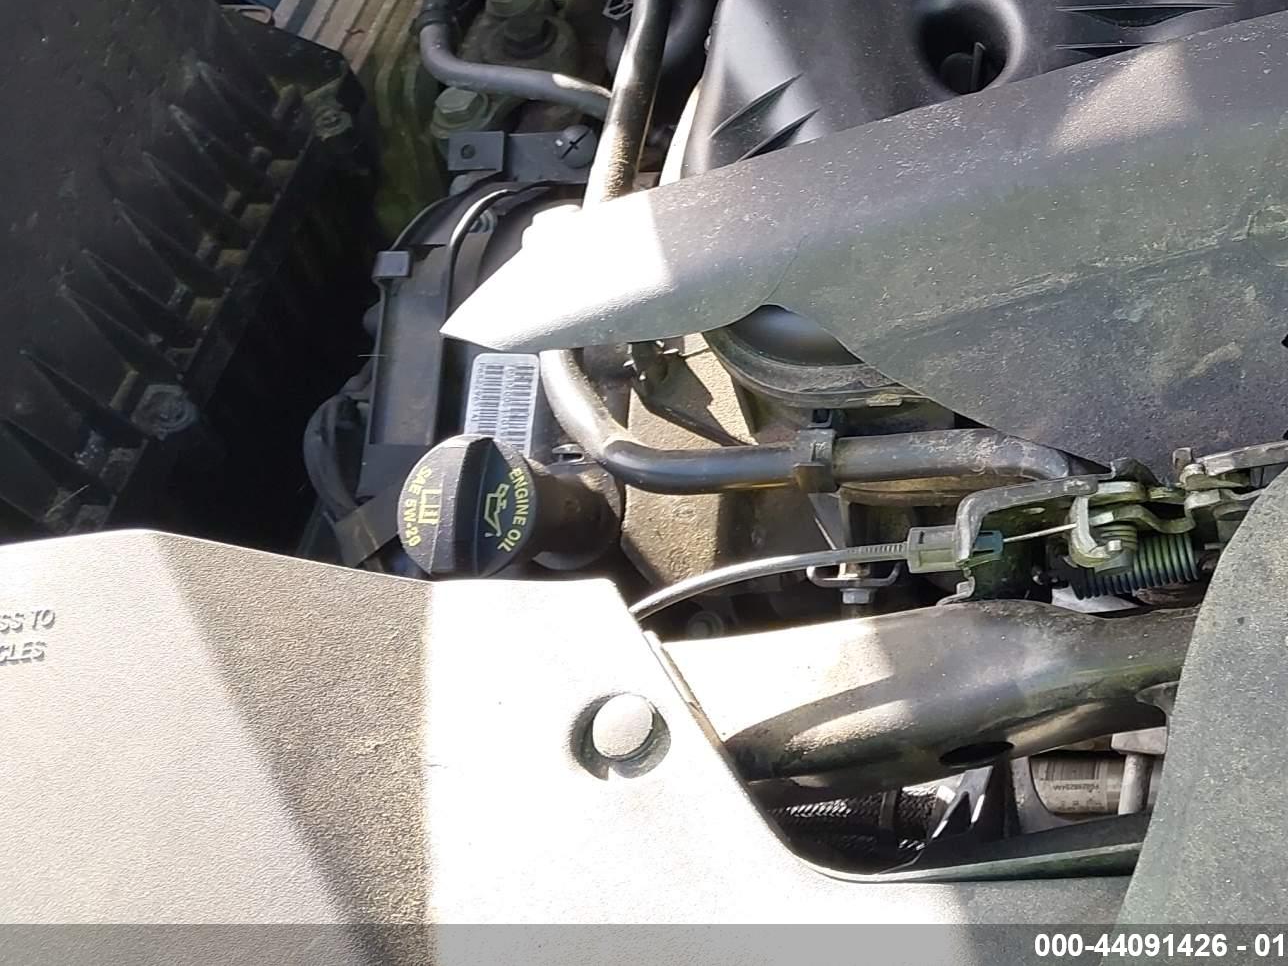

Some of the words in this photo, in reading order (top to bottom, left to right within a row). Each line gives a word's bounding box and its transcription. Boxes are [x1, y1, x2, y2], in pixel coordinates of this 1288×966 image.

[408, 465, 432, 495] SAE
[508, 467, 530, 526] ENGINE
[403, 498, 421, 547] 5W-20
[497, 529, 521, 552] OIL
[31, 609, 56, 631] TO
